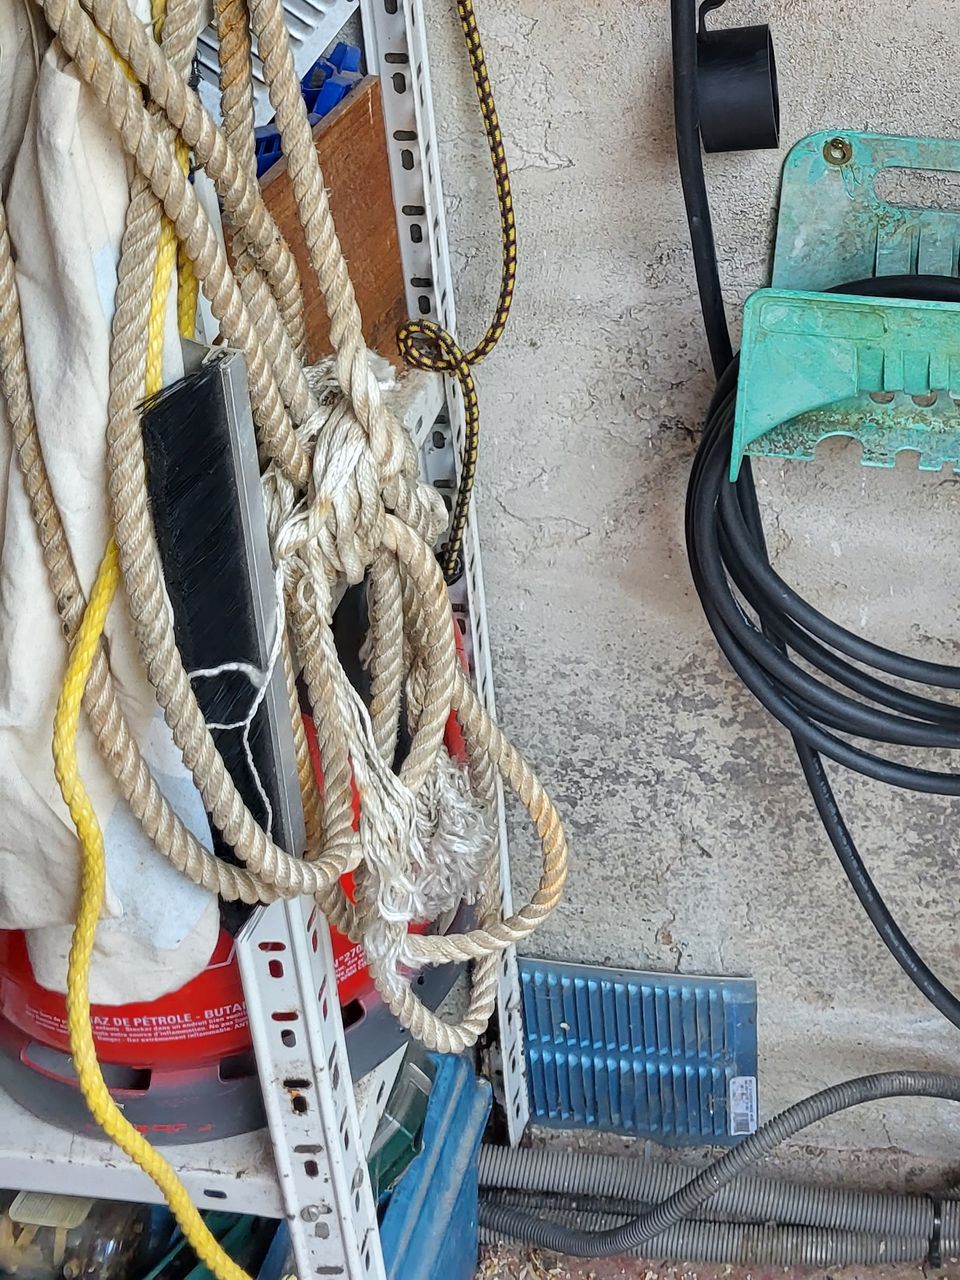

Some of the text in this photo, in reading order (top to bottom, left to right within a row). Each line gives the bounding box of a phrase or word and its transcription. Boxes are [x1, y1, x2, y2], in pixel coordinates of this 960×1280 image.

[90, 1016, 110, 1026] AZ
[112, 1017, 131, 1027] DE
[133, 1013, 193, 1027] PÉTROLE
